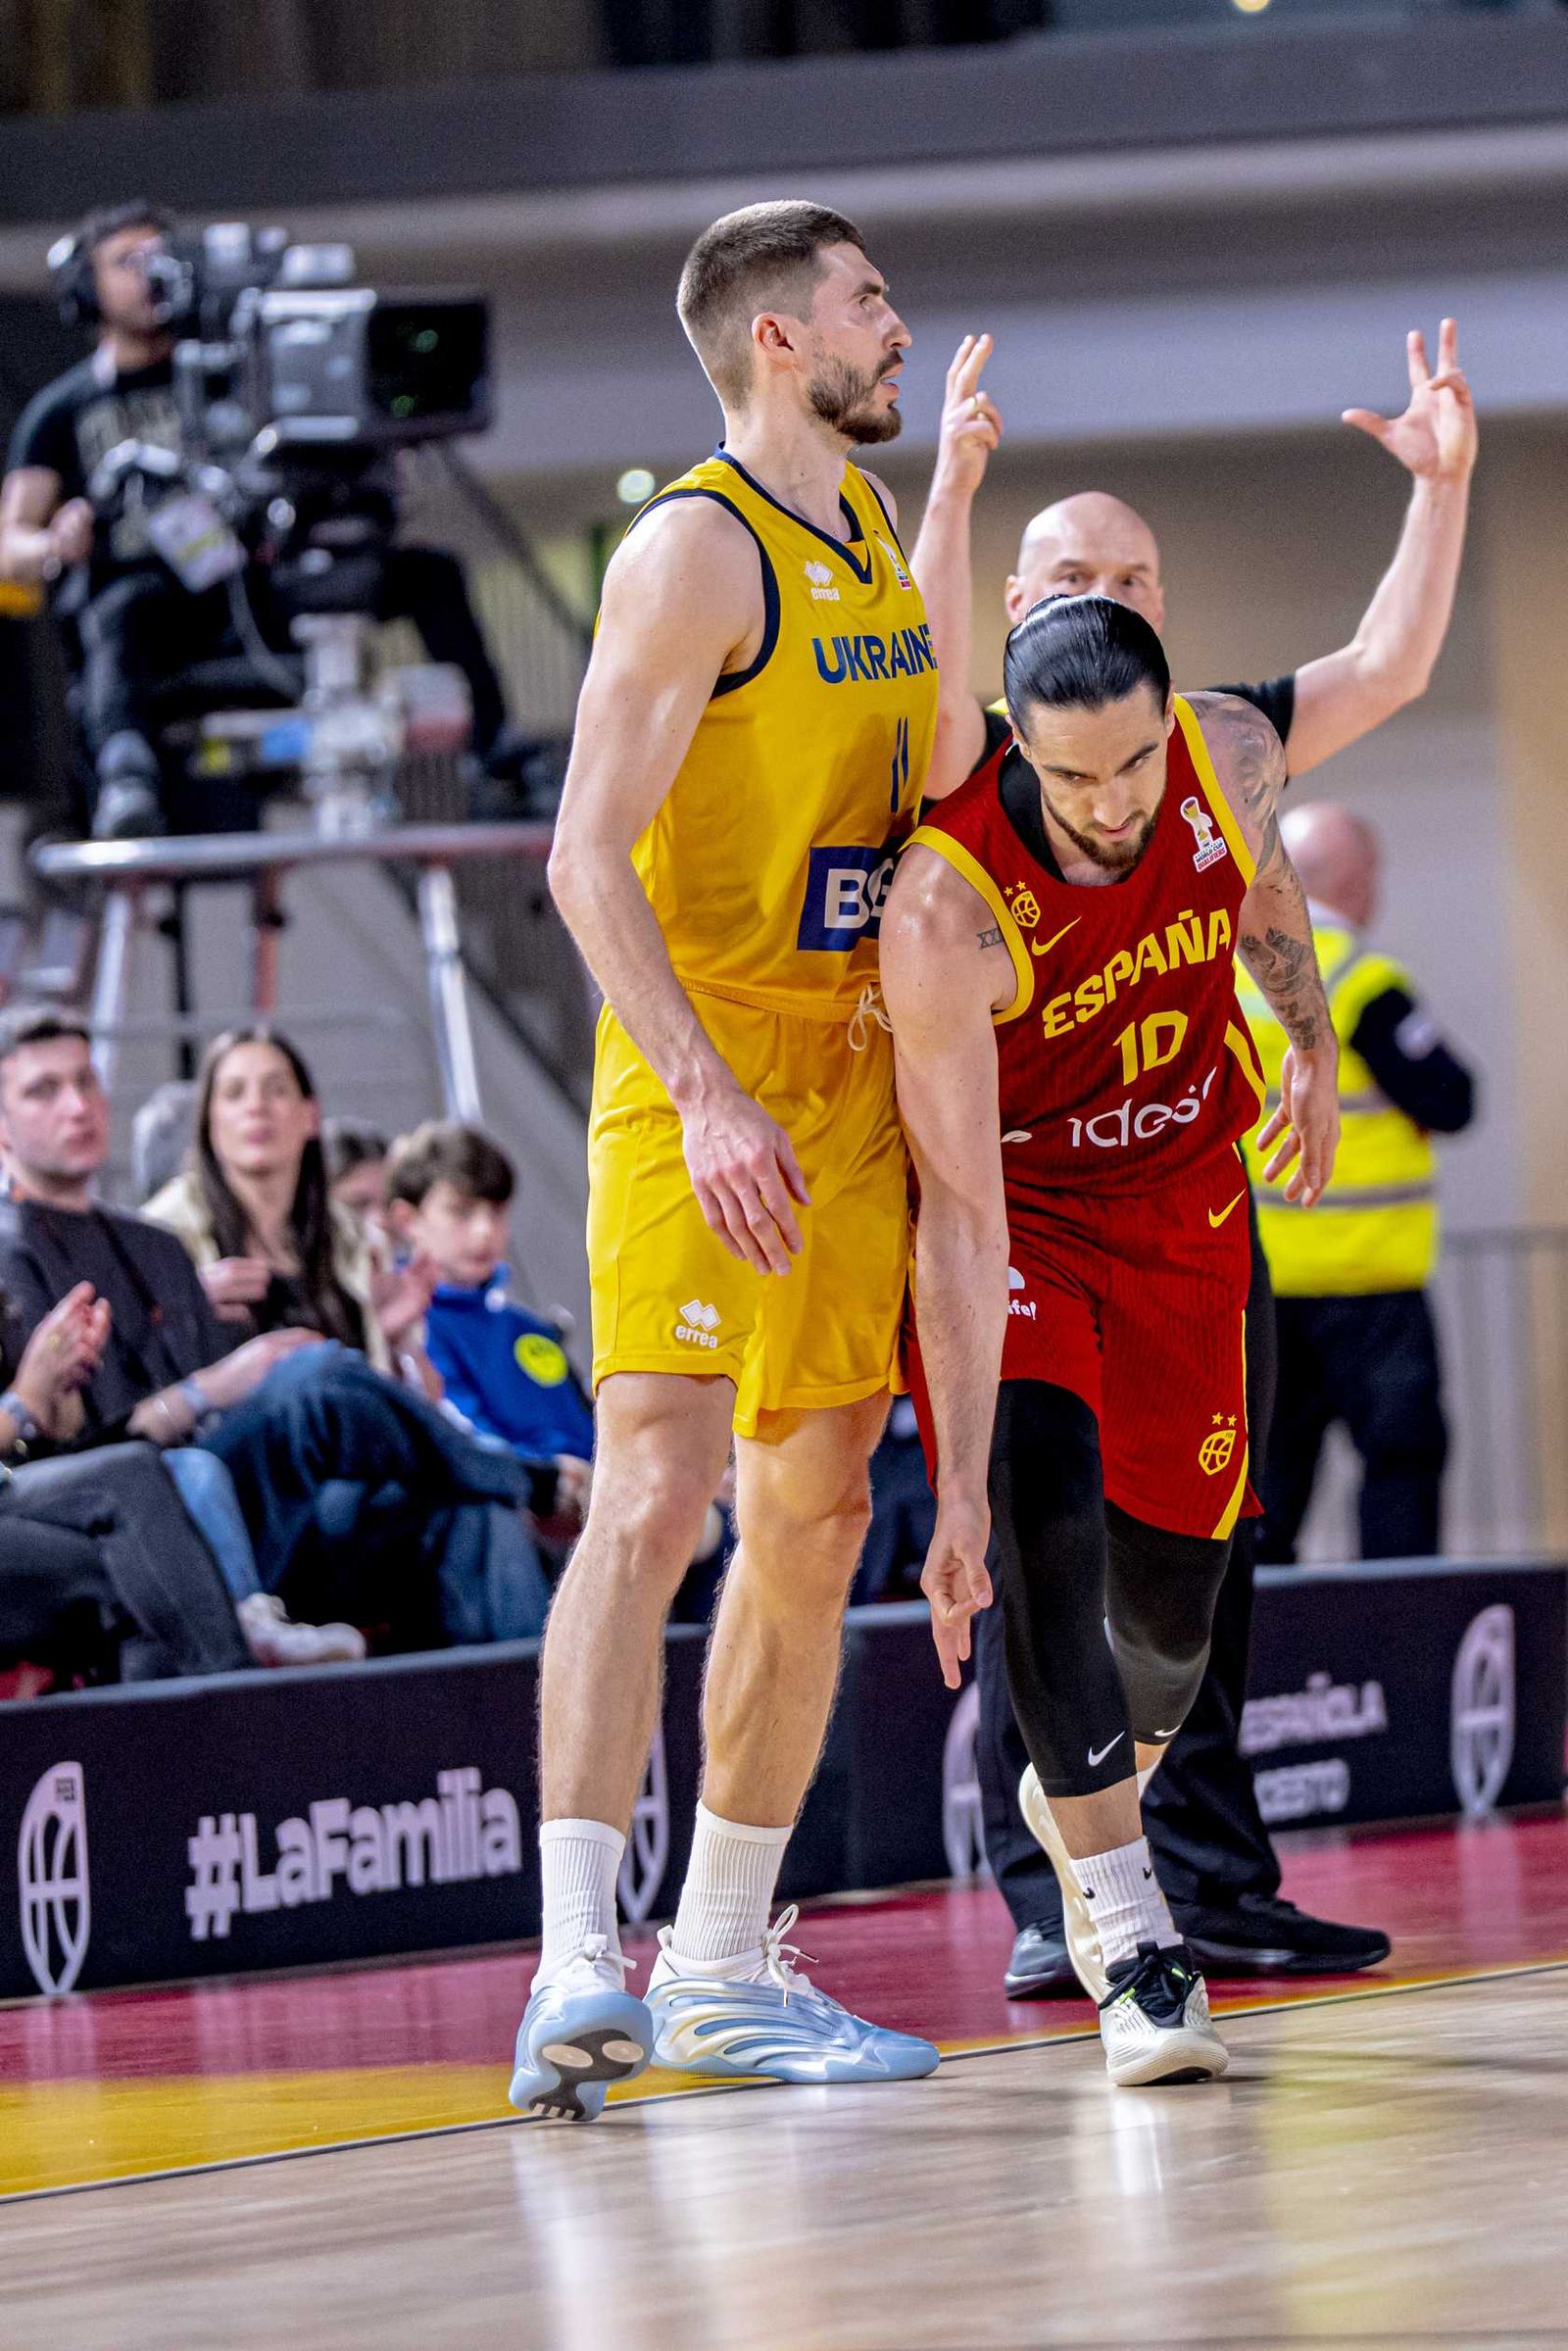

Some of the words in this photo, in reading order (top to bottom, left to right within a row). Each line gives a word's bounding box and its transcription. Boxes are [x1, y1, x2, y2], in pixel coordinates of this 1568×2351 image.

[1042, 908, 1231, 1040] ESPAÑA
[1112, 1010, 1189, 1086] 10
[675, 1325, 718, 1348] errea
[185, 1766, 521, 1940] #LaFamilia
